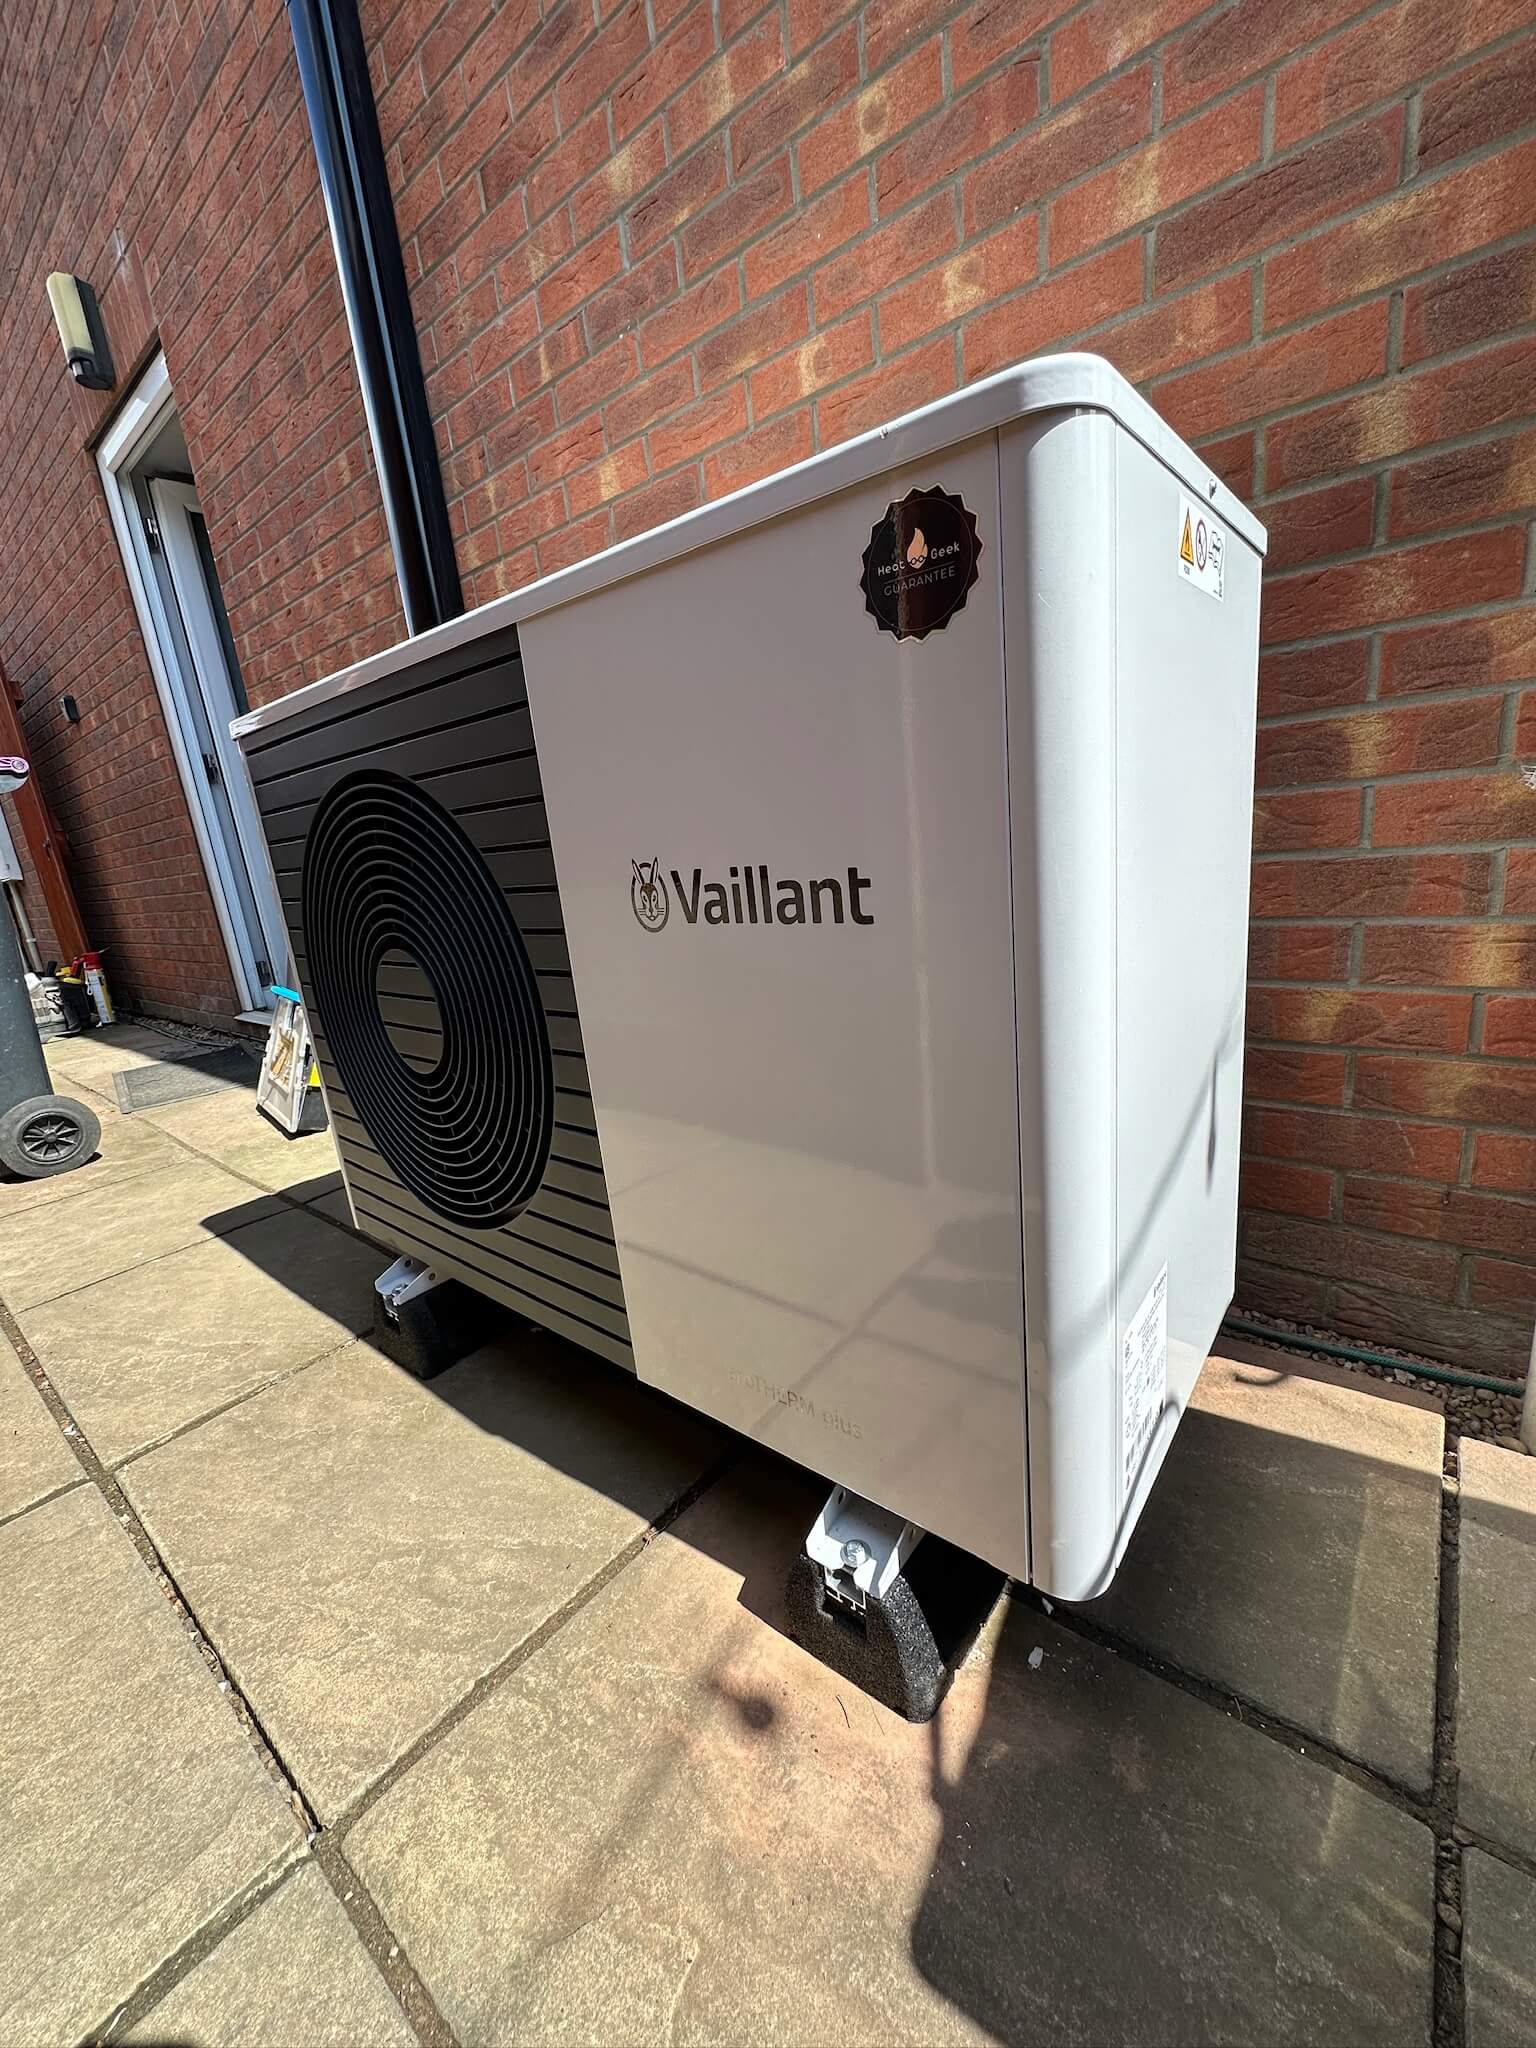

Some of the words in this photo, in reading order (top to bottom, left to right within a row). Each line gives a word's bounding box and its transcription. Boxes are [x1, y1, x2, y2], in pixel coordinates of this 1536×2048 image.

[877, 560, 906, 577] Heat
[930, 541, 960, 560] Geek
[883, 565, 957, 597] GUARANTEE
[670, 864, 874, 925] Vaillant
